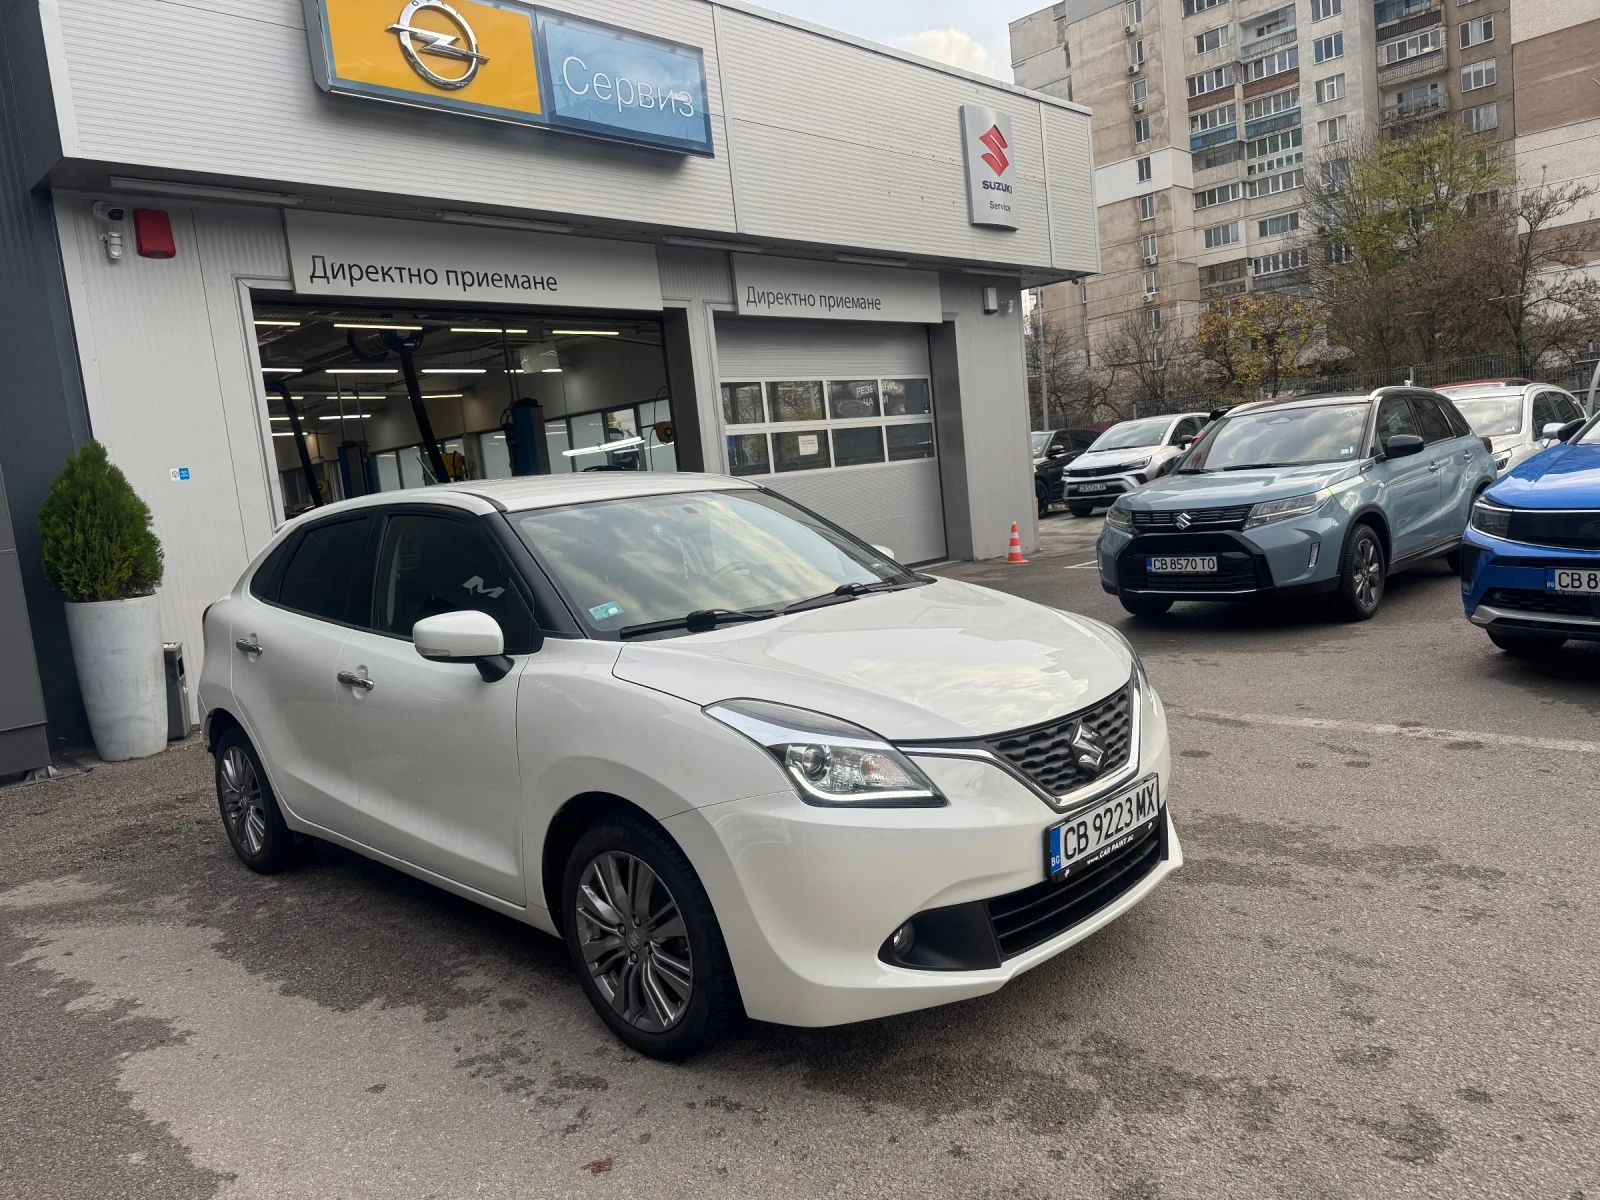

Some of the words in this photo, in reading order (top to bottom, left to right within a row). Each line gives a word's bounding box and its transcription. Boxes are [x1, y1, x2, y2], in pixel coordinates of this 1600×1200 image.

[562, 56, 695, 117] Сервиз
[982, 180, 1012, 194] SUZUKI
[989, 200, 1011, 212] Service
[310, 254, 439, 287] Директно
[445, 269, 558, 292] приемане
[746, 286, 816, 309] Директно
[819, 294, 881, 312] приемане
[1153, 558, 1168, 570] CB
[1170, 558, 1197, 570] 8570
[1199, 557, 1215, 570] TO
[1558, 571, 1582, 589] CB
[1587, 572, 1600, 590] 8
[1063, 820, 1089, 860] CB
[1092, 796, 1134, 845] 9223
[1136, 783, 1155, 822] MX
[1099, 847, 1111, 858] CAR
[1051, 855, 1060, 867] BG
